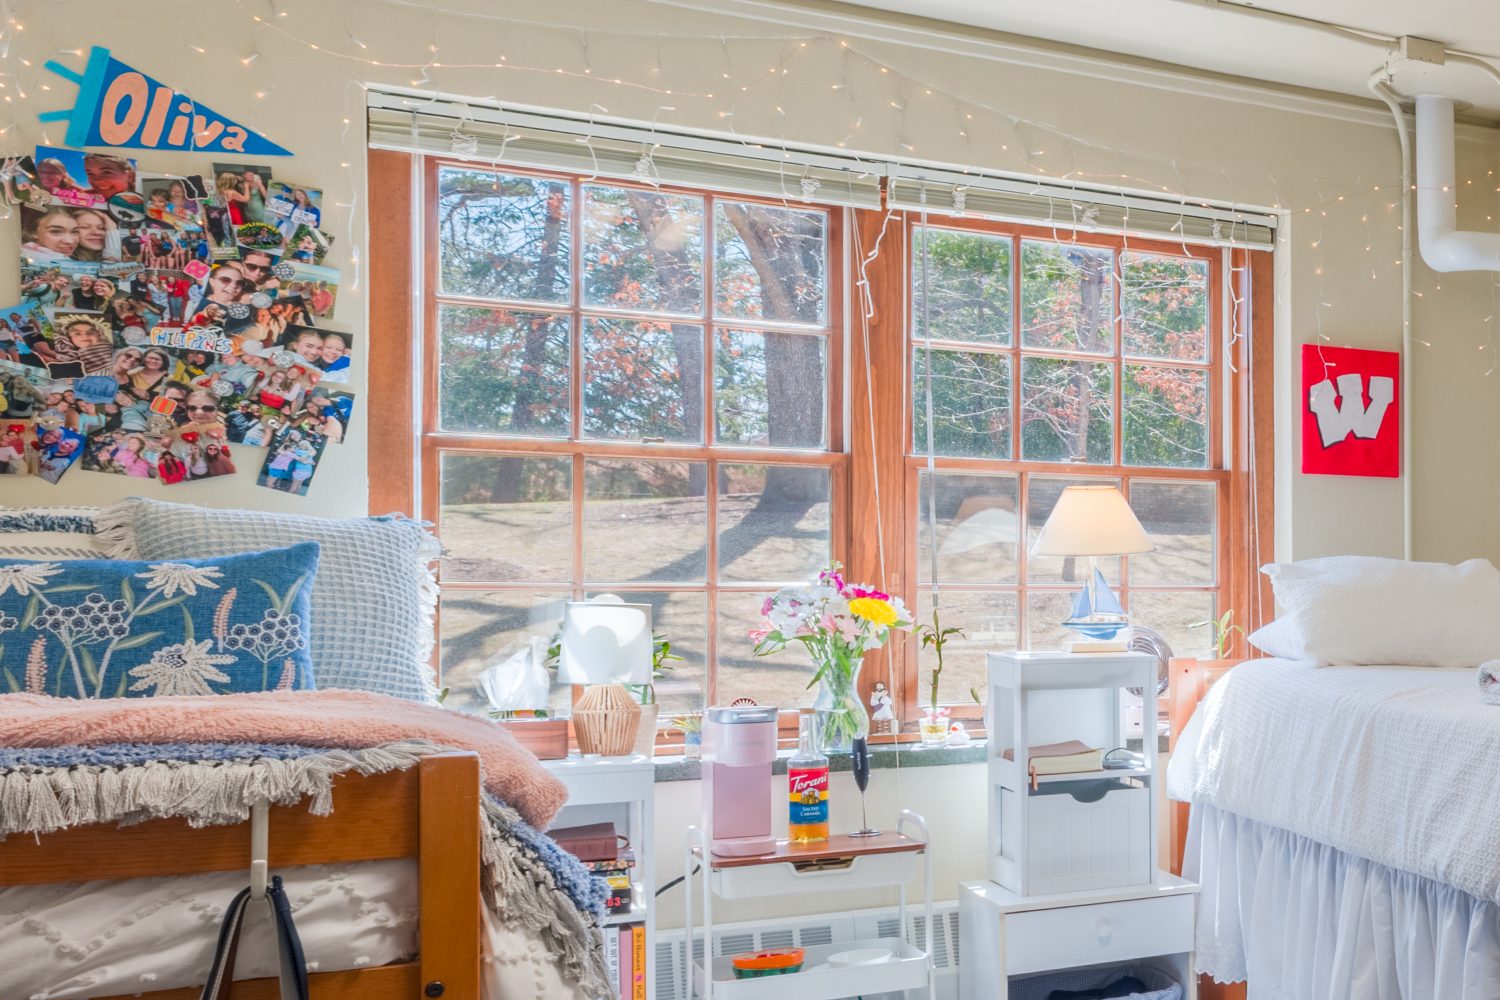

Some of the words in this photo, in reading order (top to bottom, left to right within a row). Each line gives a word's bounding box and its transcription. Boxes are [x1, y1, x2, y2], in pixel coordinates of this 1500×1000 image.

[100, 72, 248, 152] Oliva
[1308, 373, 1394, 450] W
[790, 772, 828, 794] Torani
[636, 932, 644, 943] The
